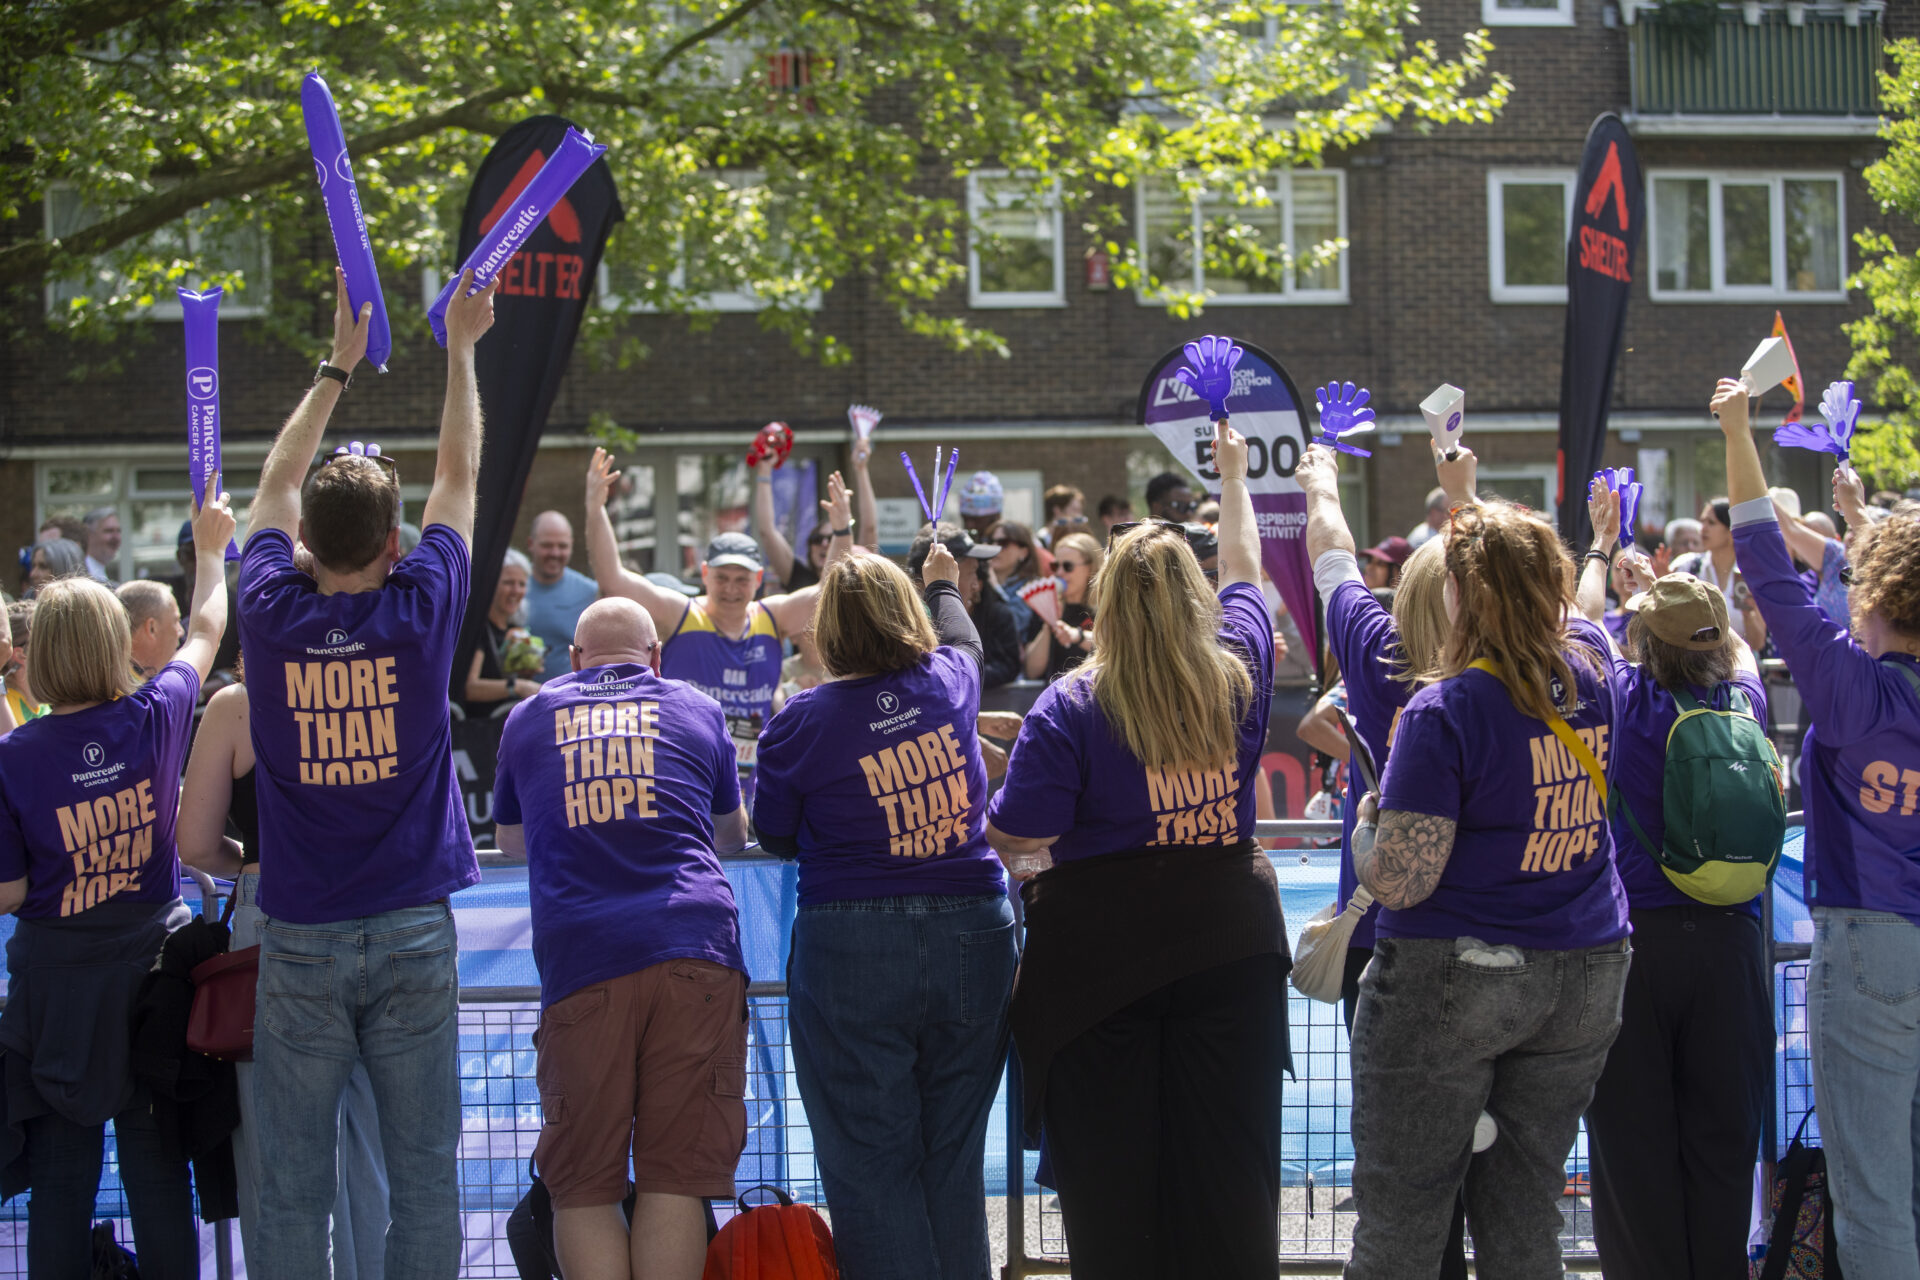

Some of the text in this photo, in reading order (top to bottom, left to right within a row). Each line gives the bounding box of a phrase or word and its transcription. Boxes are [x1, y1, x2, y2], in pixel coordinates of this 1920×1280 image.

[350, 188, 368, 250] CANCER UK
[476, 204, 540, 280] Pancreatic
[1233, 368, 1255, 378] DON
[192, 448, 199, 462] UK
[1256, 512, 1308, 526] SPIRING
[1258, 526, 1302, 539] CTIVITY
[306, 642, 366, 655] Pancreatic
[284, 656, 400, 710] MORE
[580, 680, 635, 692] Pancreatic
[294, 707, 398, 760] THAN
[554, 701, 660, 745] MORE
[870, 706, 922, 732] Pancreatic
[883, 719, 917, 736] CANCER UK
[72, 762, 126, 783] Pancreatic
[560, 736, 655, 783] THAN
[858, 723, 967, 797] MORE
[1530, 724, 1609, 786] MORE
[84, 778, 108, 788] CANCER
[564, 778, 659, 828] HOPE
[877, 770, 972, 836] THAN
[1534, 780, 1602, 830] THAN
[1859, 760, 1920, 816] ST
[56, 778, 156, 852] MORE
[889, 811, 970, 859] HOPE
[1156, 794, 1238, 842] THAN
[71, 824, 153, 877] THAN
[1520, 824, 1600, 872] HOPE
